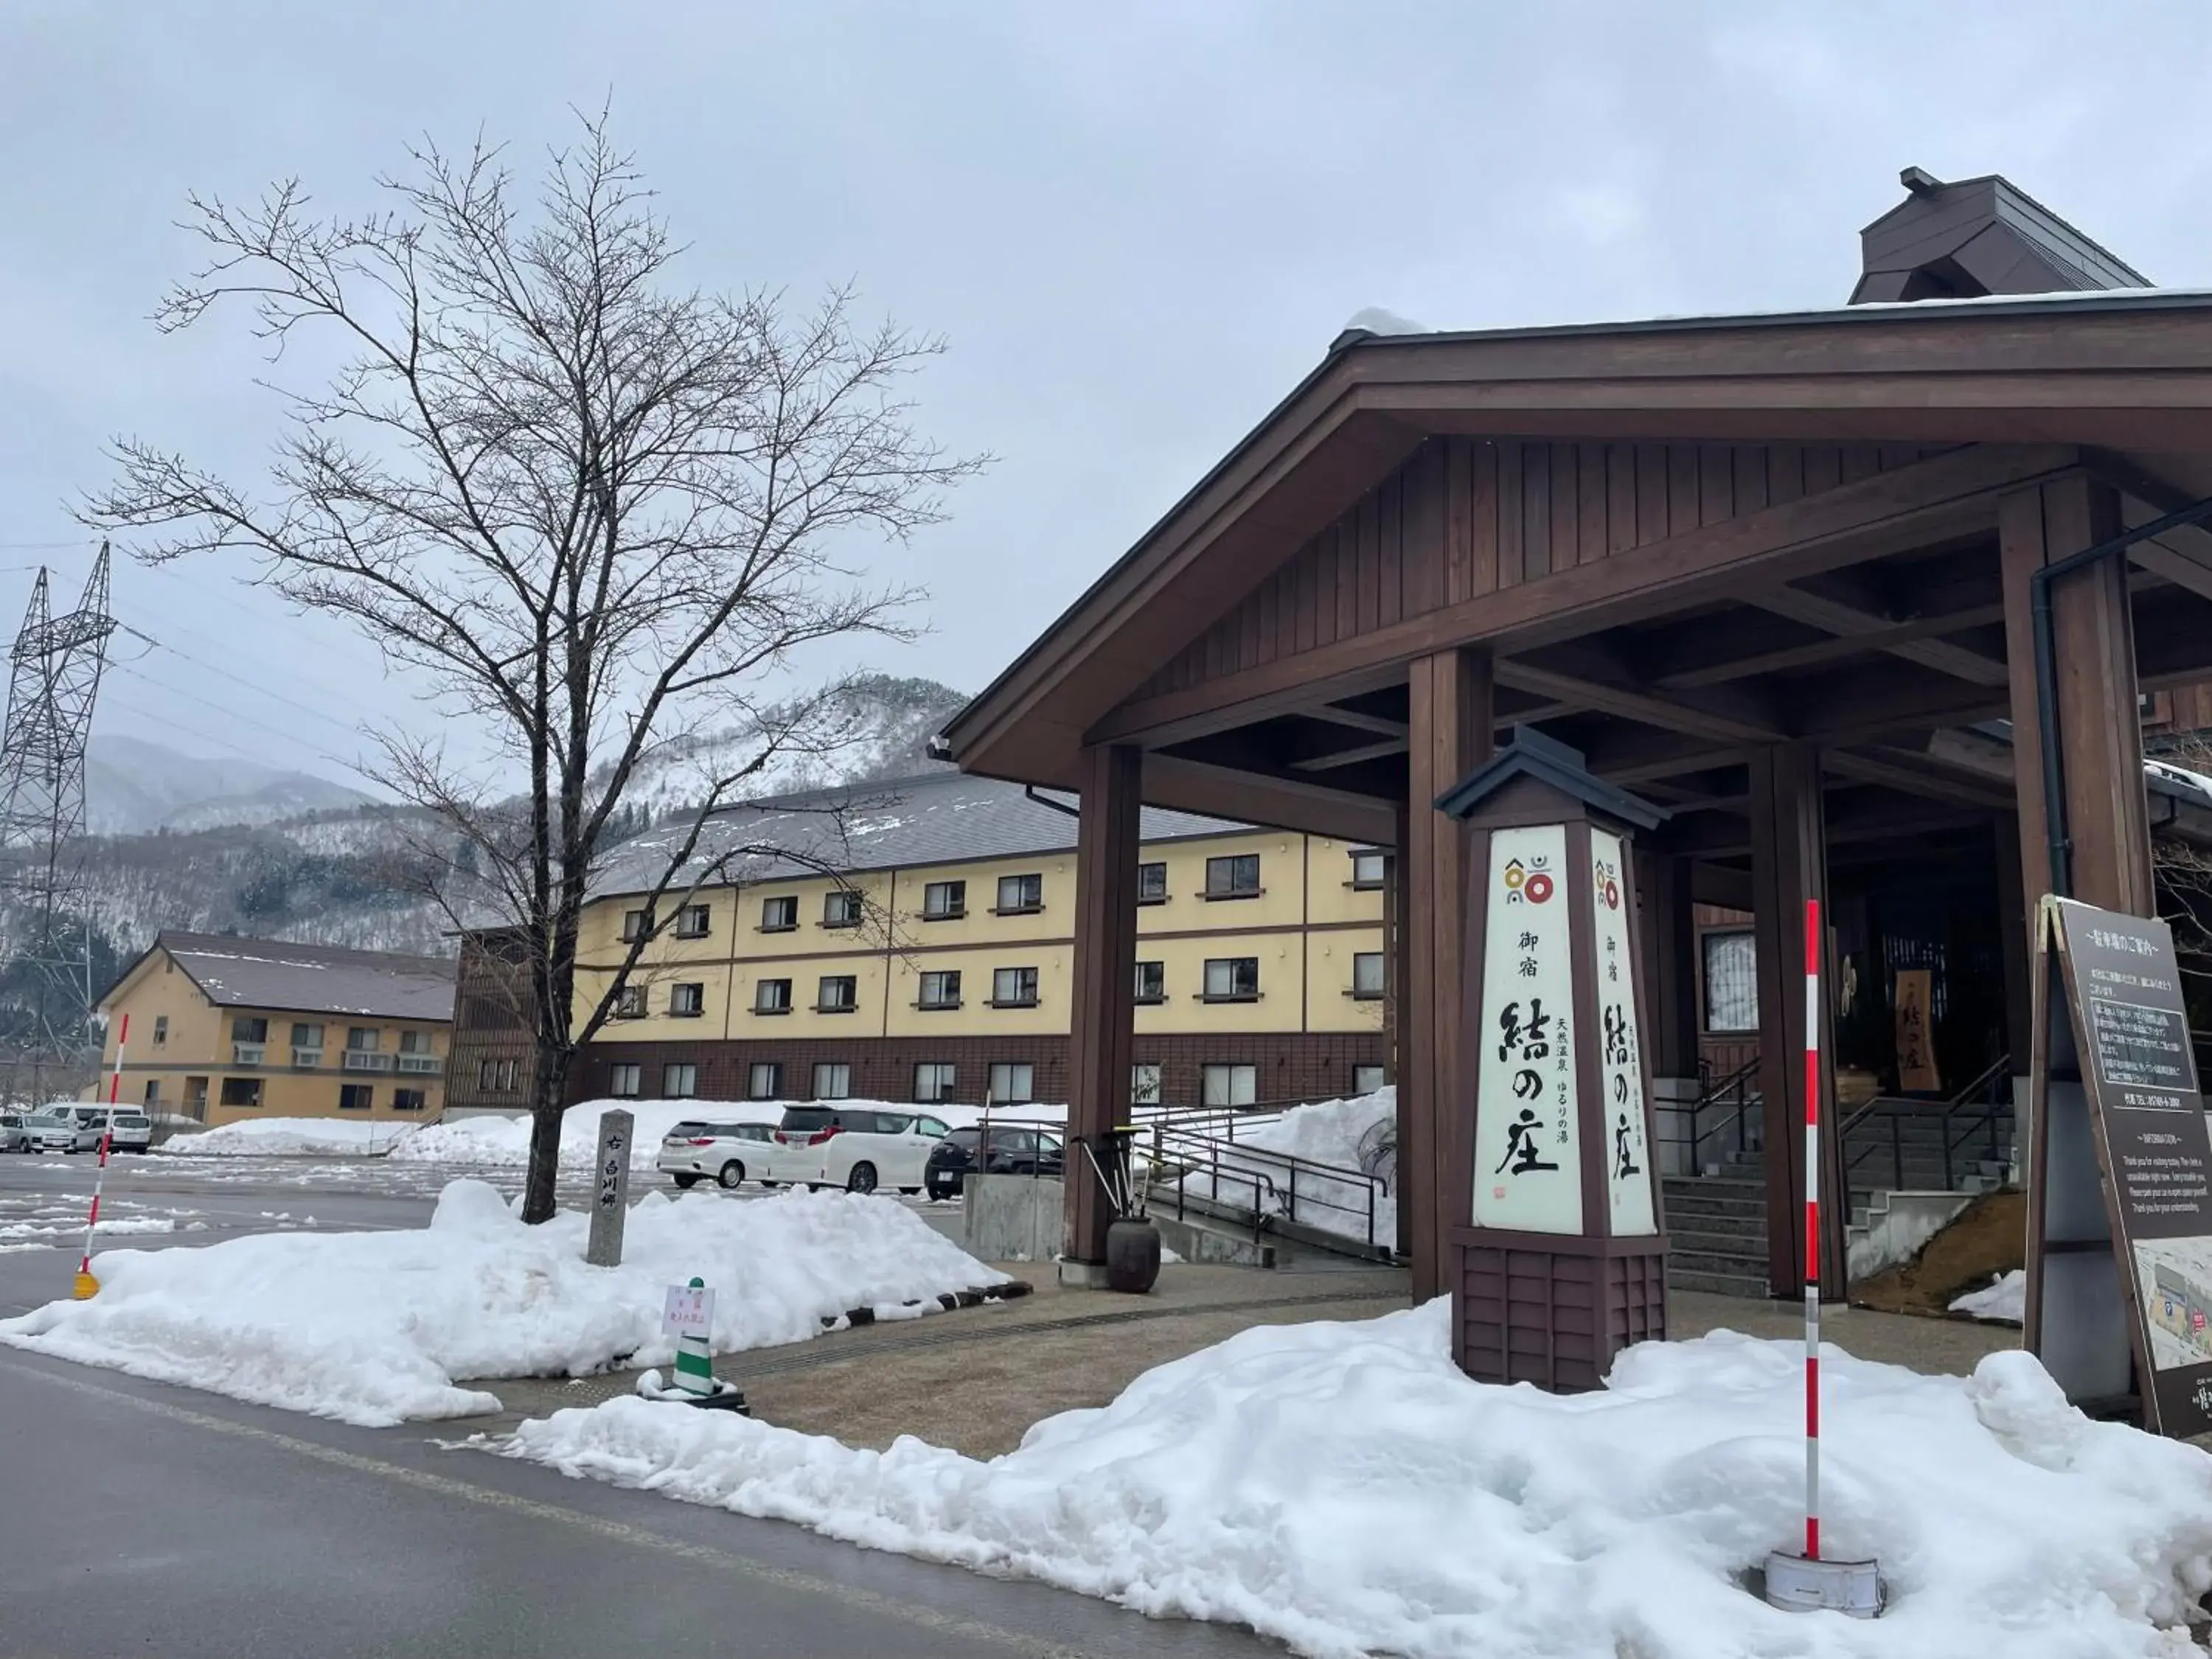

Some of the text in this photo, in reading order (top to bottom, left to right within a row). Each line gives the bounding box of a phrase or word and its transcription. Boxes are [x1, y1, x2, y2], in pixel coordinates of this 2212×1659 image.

[1495, 931, 1559, 1176] 御宿 結の庄
[1557, 1018, 1569, 1144] 天然温泉 ゆるりの湯
[1604, 1004, 1641, 1181] 結の庄
[601, 1160, 619, 1208] 白川郷
